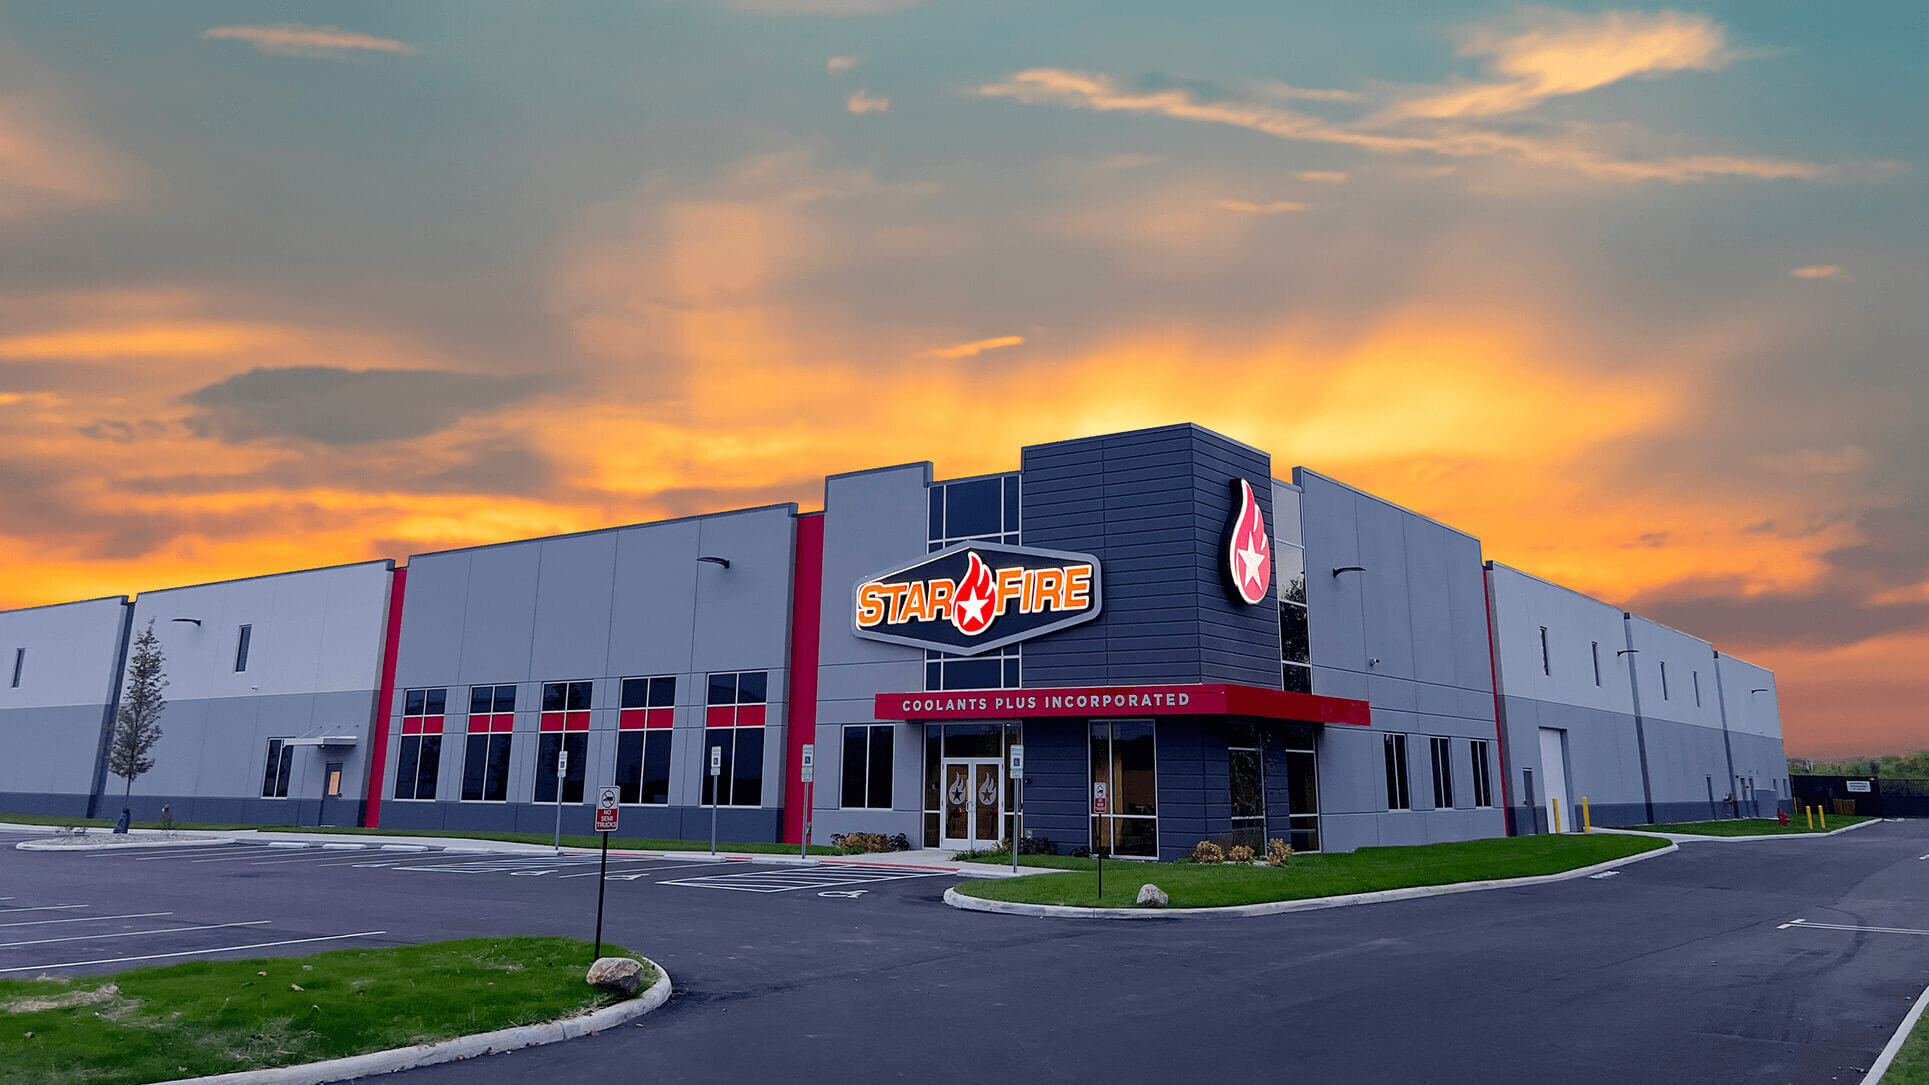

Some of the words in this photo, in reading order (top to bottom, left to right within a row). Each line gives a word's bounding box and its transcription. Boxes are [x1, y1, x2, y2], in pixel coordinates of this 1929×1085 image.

[856, 581, 955, 627] STAR
[995, 564, 1092, 615] FIRE
[902, 698, 987, 712] COOLANTS
[995, 696, 1037, 709] PLUS
[1045, 693, 1190, 708] INCORPORATED
